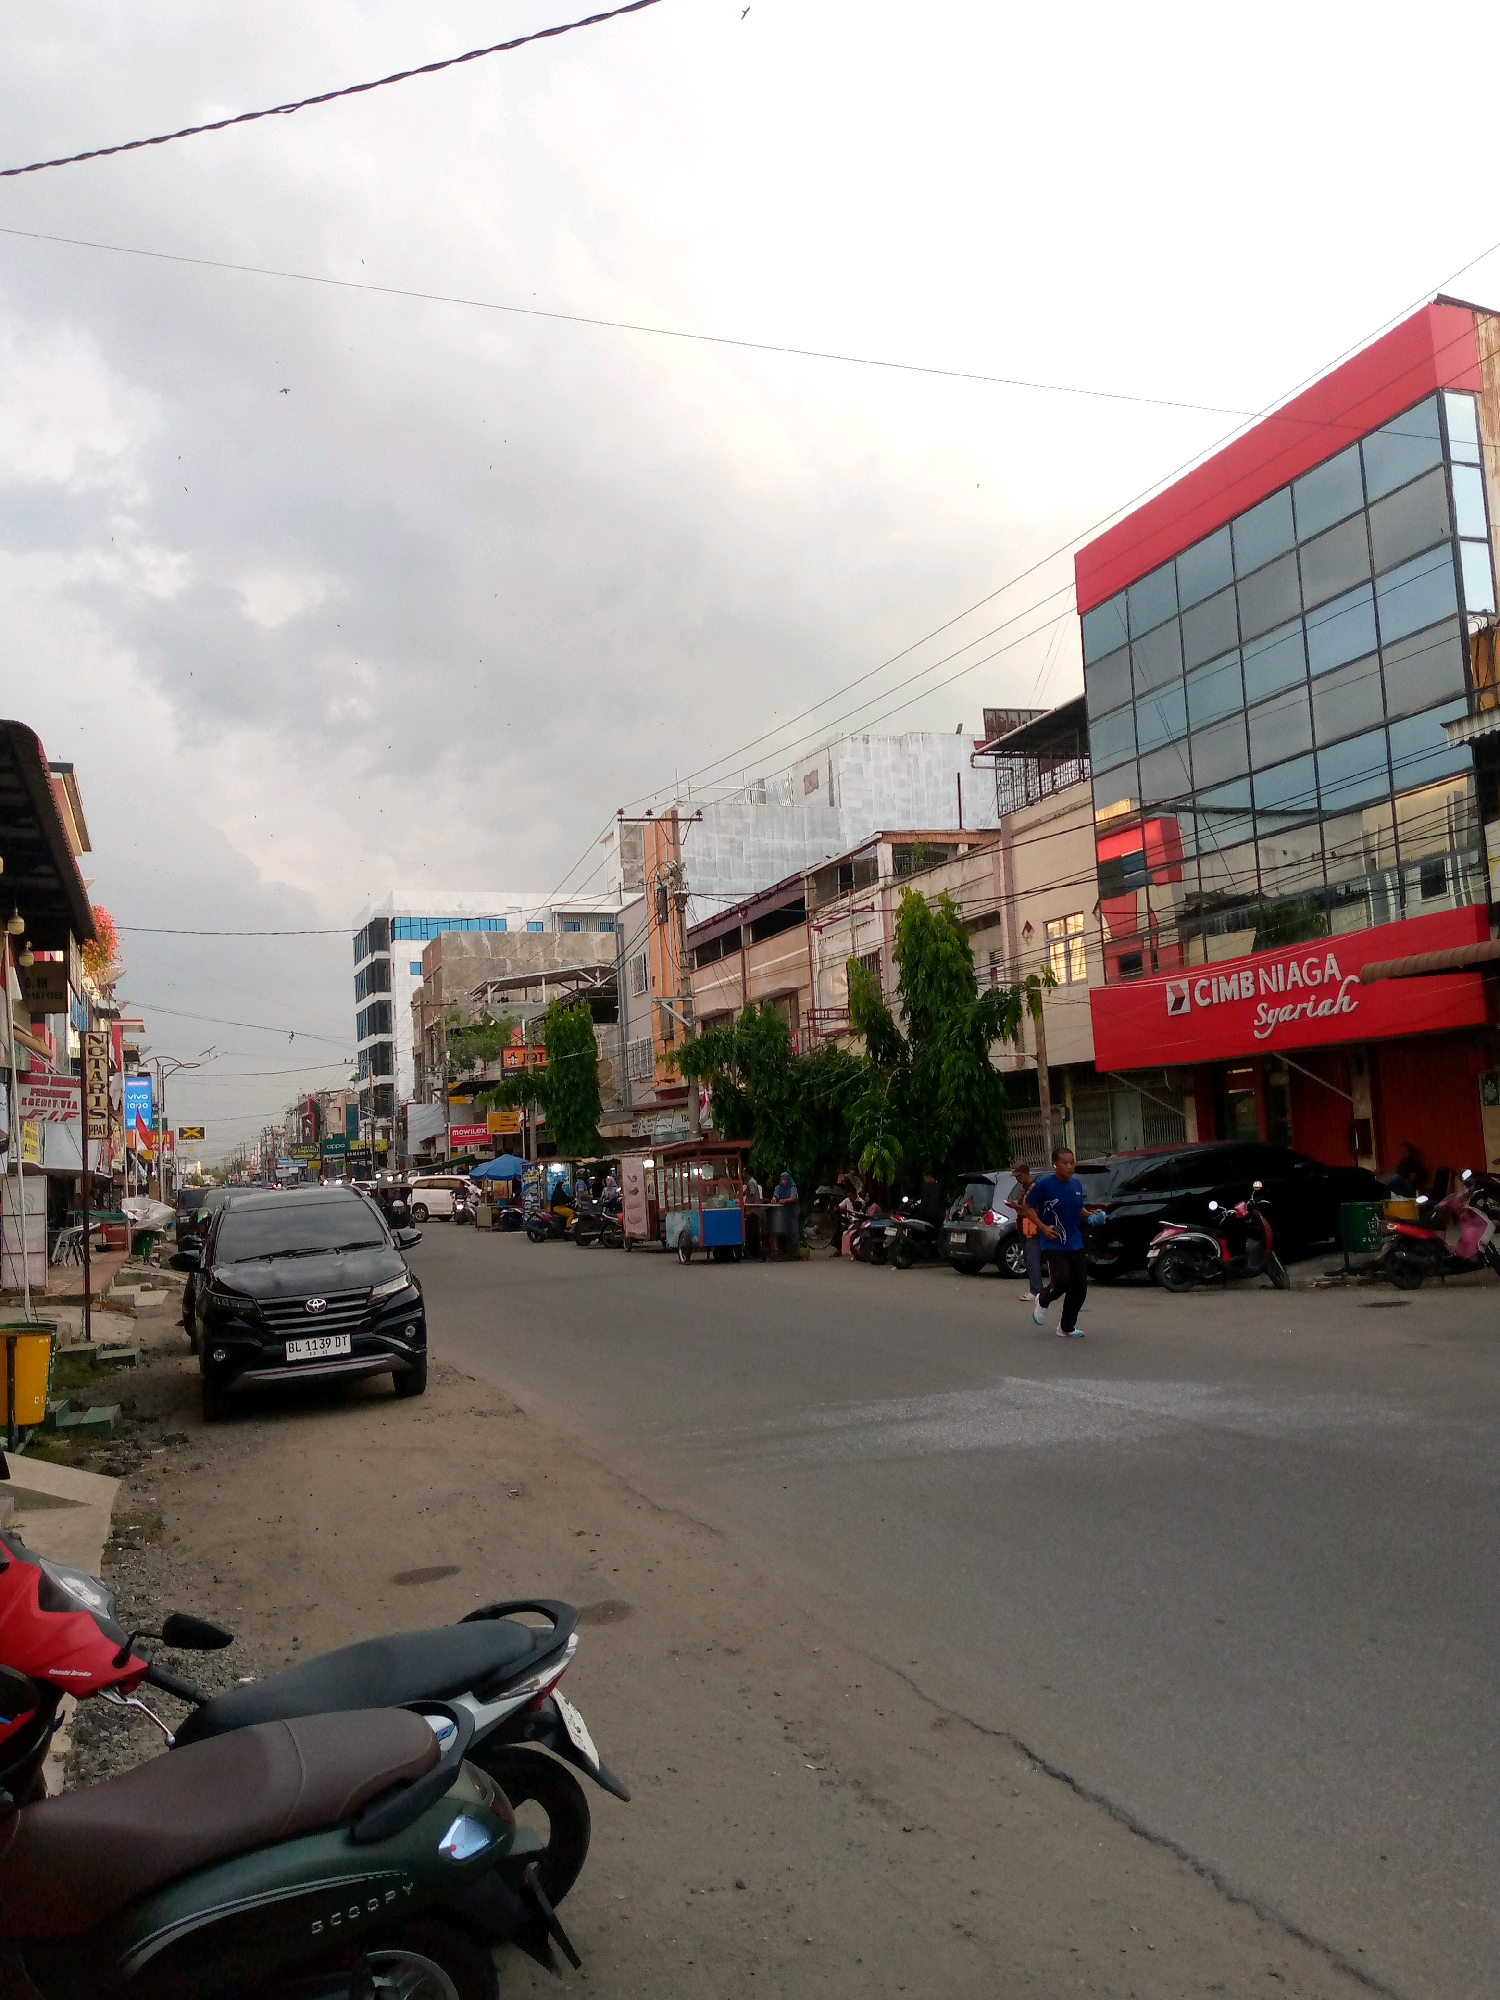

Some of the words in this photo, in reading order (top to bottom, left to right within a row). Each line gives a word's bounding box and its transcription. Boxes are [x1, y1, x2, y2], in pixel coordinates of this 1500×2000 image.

[1194, 971, 1255, 1007] CIMB
[1258, 953, 1342, 995] NIAGA
[1253, 975, 1361, 1039] Syariah
[21, 1097, 58, 1108] KREDIT
[60, 1099, 78, 1110] VIA
[88, 1034, 106, 1119] NOTARIS
[88, 1123, 106, 1135] PPAT
[288, 1342, 302, 1353] BL
[305, 1337, 332, 1351] 1139
[335, 1336, 348, 1348] DT
[311, 1881, 414, 1935] SCOOPY
